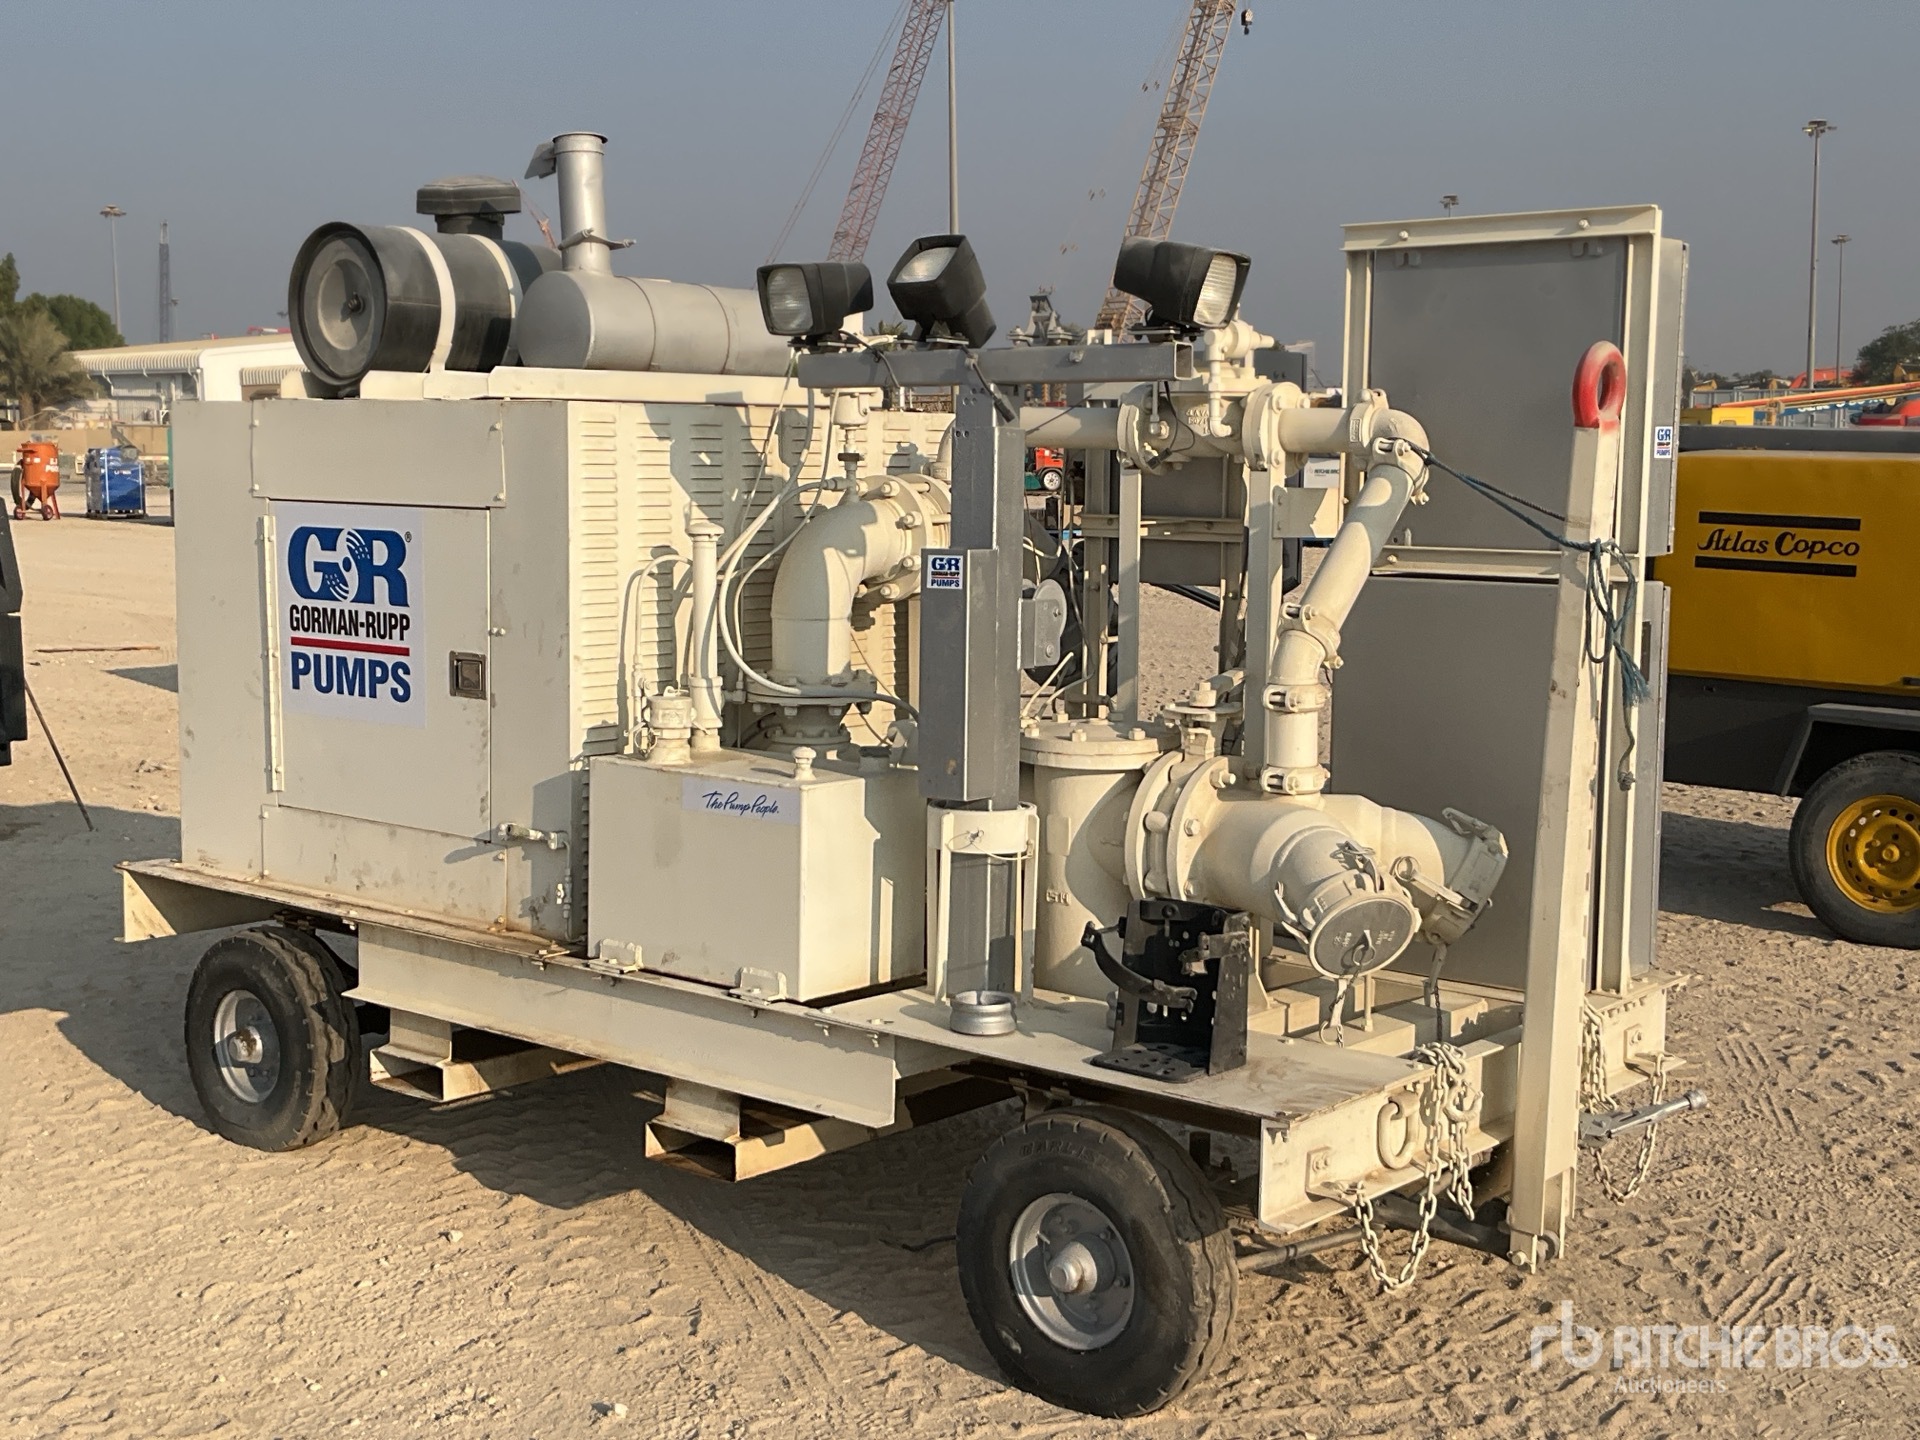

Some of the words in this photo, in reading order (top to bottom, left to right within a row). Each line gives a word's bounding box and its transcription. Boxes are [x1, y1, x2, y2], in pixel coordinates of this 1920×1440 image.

[1697, 528, 1769, 554] Atlas
[1774, 531, 1861, 559] Copco
[931, 579, 960, 587] PUMPS
[289, 604, 411, 641] GORMAN-RUPP
[290, 651, 411, 703] PUMPS
[702, 791, 723, 809] The
[723, 791, 751, 816] Pump
